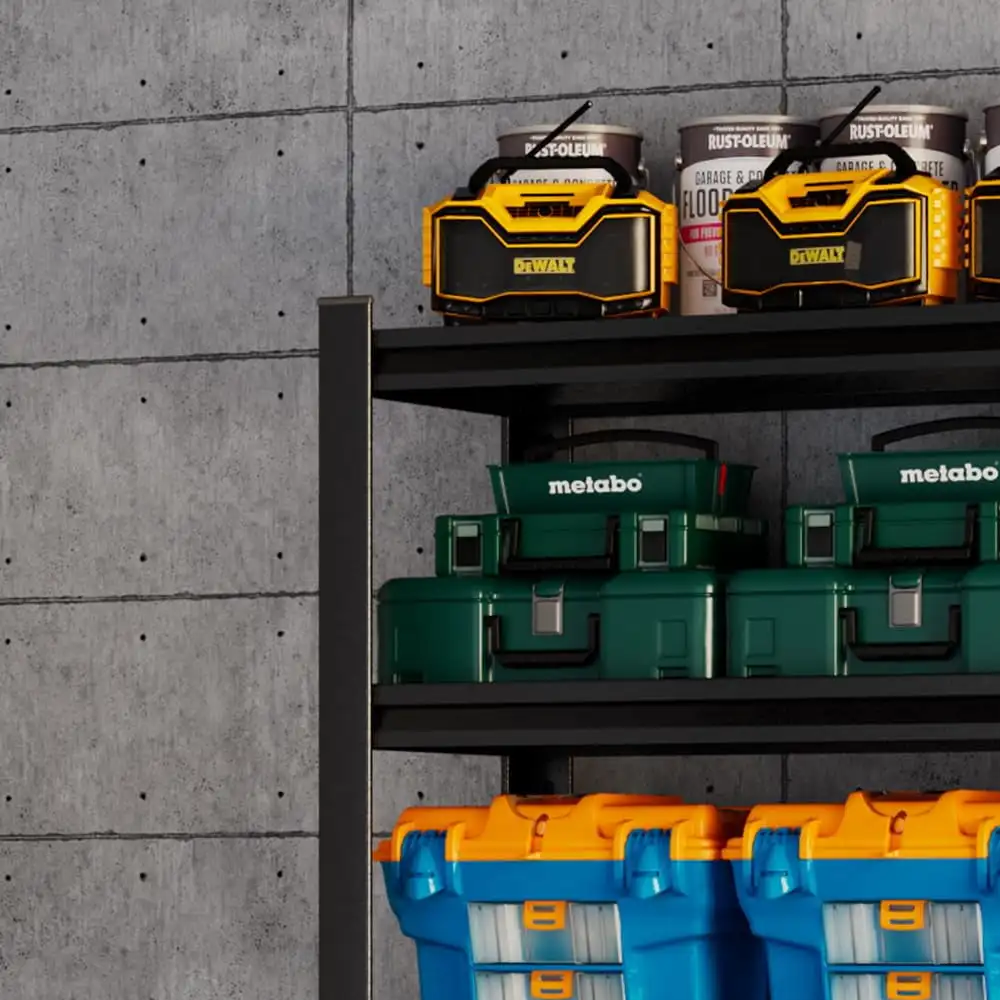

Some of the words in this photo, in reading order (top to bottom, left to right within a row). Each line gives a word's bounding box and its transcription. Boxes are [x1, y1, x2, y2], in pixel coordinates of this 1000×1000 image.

[849, 124, 933, 140] RUST-OLEUM
[708, 134, 790, 150] RUST-OLEUM
[695, 170, 732, 186] GARAGE
[736, 170, 744, 184] &
[683, 188, 733, 219] FLOO
[900, 463, 999, 483] metabo
[548, 475, 642, 494] metabo
